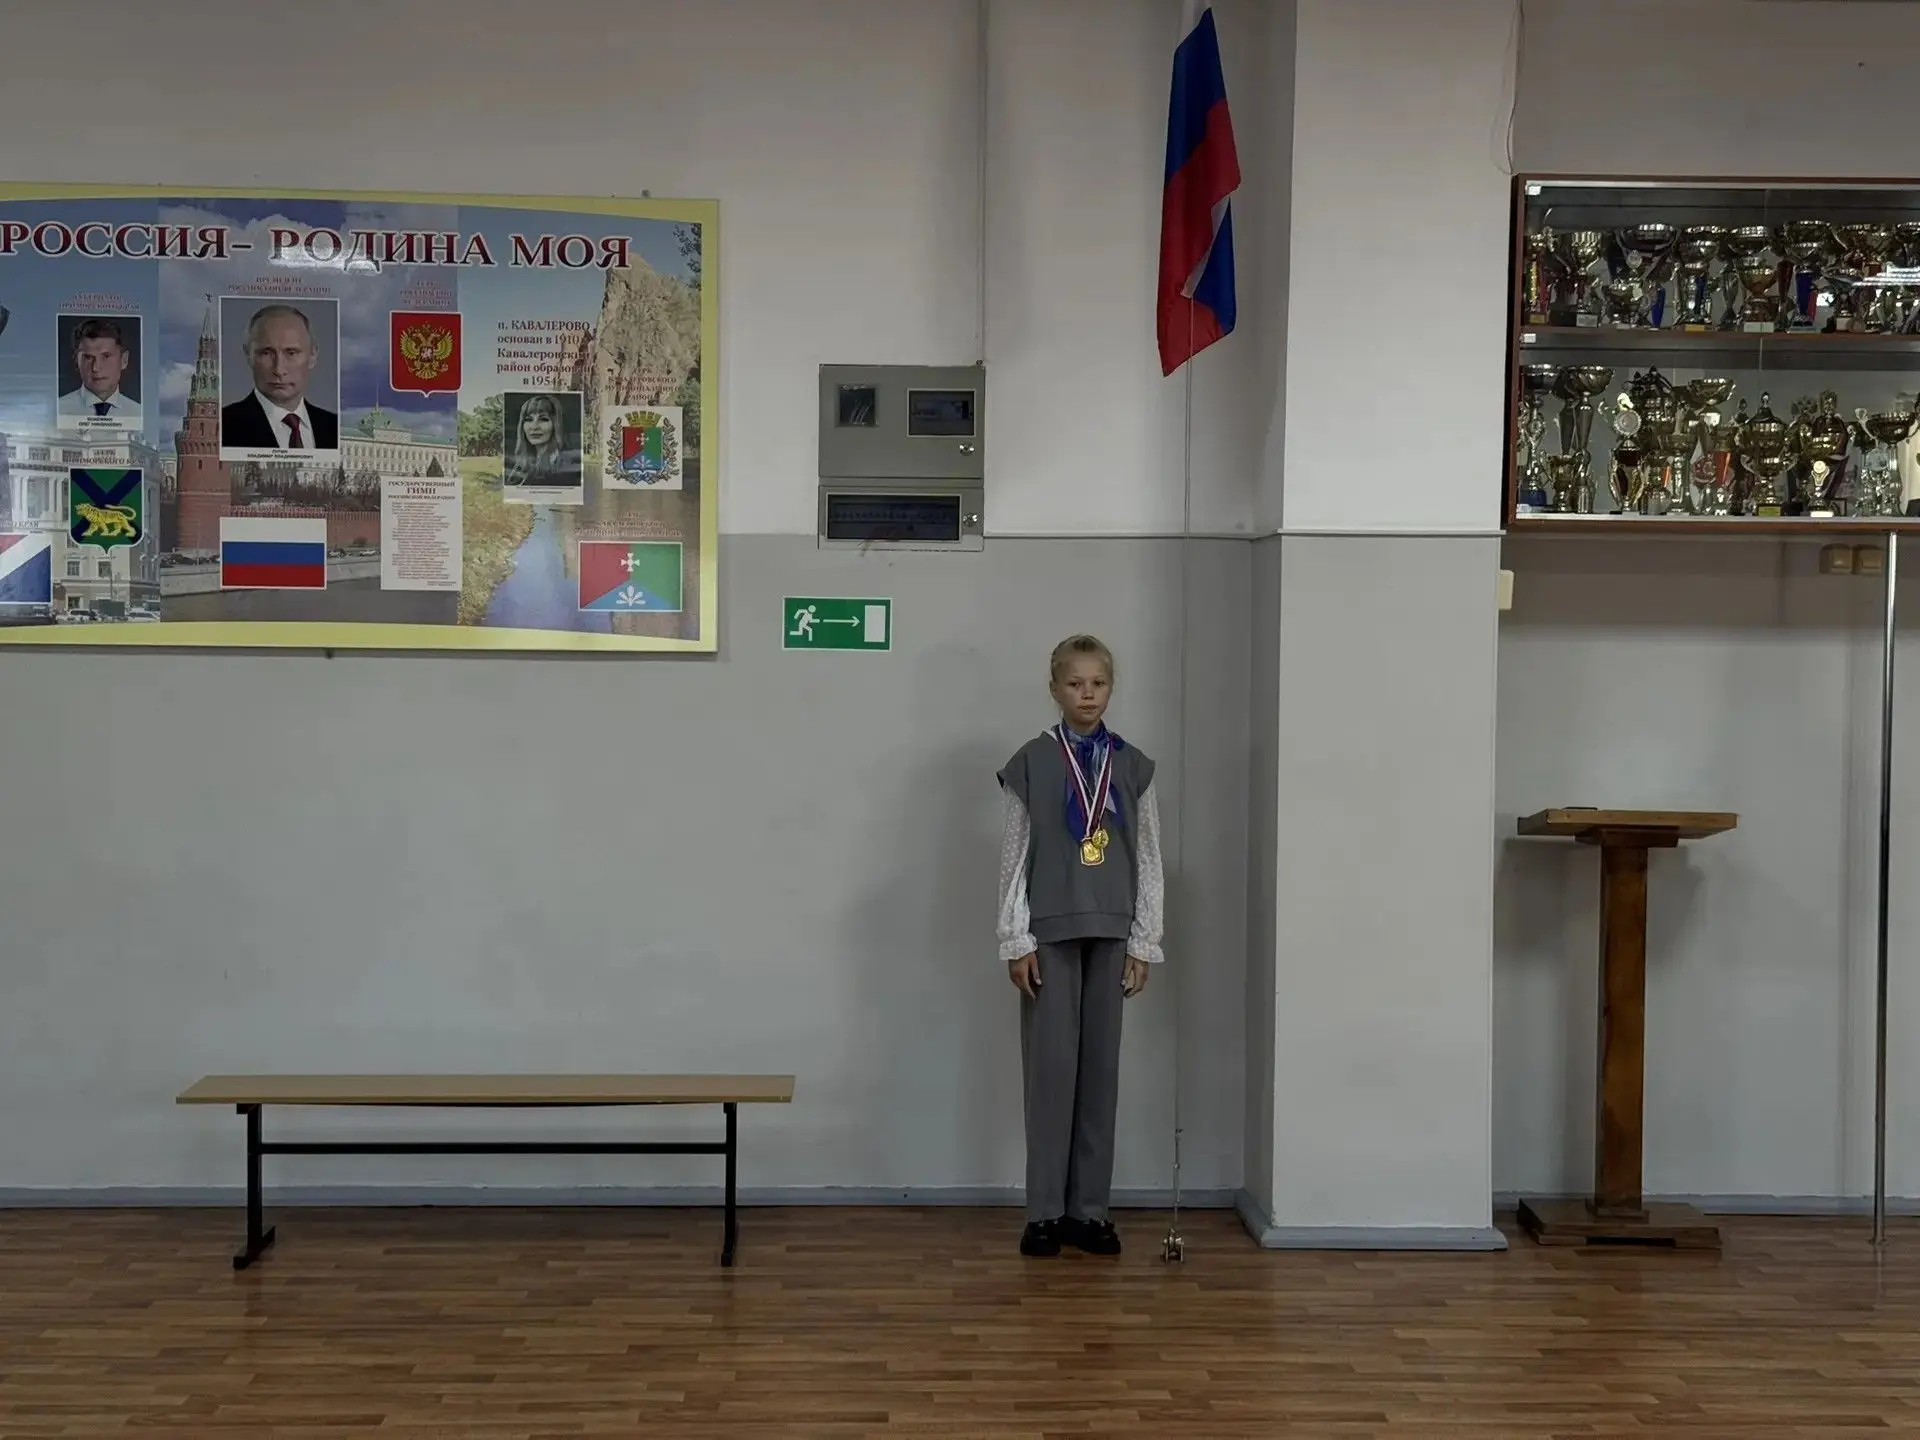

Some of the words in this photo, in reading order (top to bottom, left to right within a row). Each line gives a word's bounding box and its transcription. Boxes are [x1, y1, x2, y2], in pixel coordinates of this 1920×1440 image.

[270, 229, 495, 272] РОДИНА
[511, 235, 631, 268] МОЯ
[511, 320, 590, 331] КАВАЛЕРОВО
[497, 335, 543, 344] основан
[554, 334, 580, 345] 1910
[496, 362, 531, 373] район
[523, 377, 529, 385] в
[407, 487, 436, 495] ГИМН
